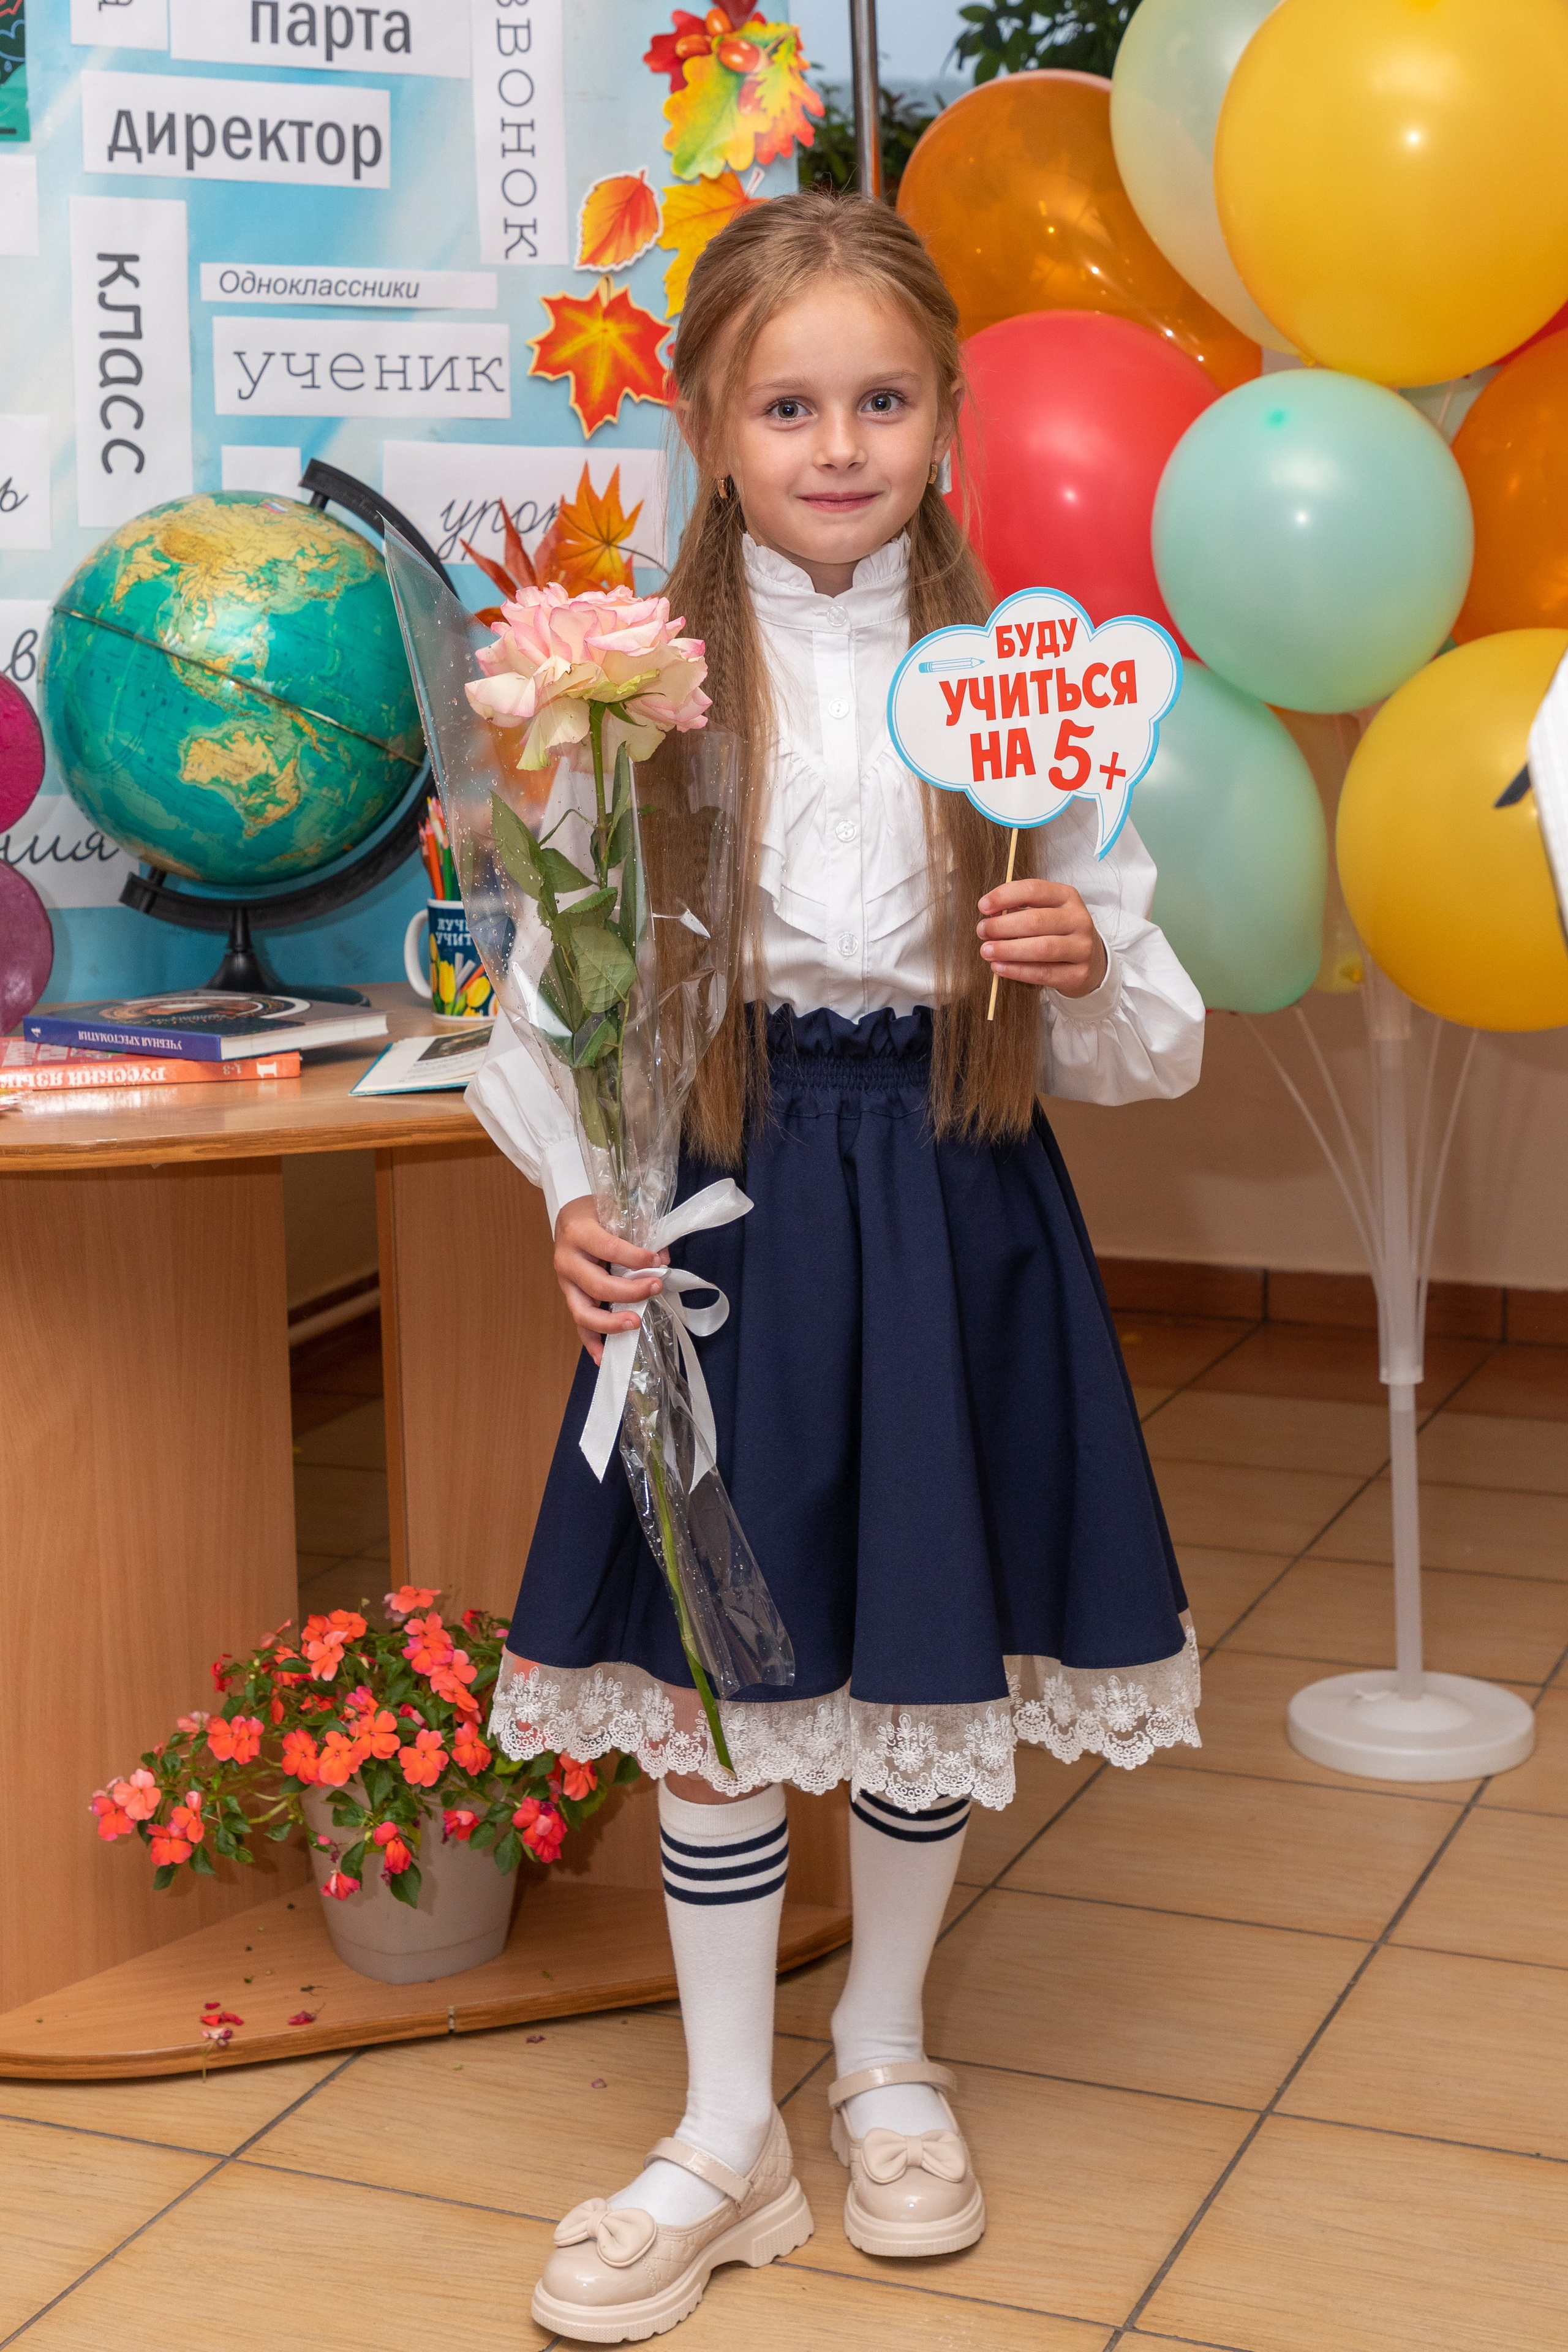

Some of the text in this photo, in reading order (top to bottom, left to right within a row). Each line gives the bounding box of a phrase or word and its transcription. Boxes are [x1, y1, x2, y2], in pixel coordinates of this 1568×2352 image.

[251, 0, 412, 62] парта
[107, 108, 383, 180] директор
[496, 0, 538, 260] вонок
[219, 269, 421, 300] Одноклассники
[96, 252, 145, 475] класс
[233, 350, 505, 401] ученик
[995, 617, 1079, 660] БУДУ
[938, 658, 1138, 727] УЧИТЬСЯ
[970, 726, 1036, 783] НА
[437, 918, 470, 932] ЛУЧ
[78, 1030, 183, 1050] УЧЕБНАЯ ХРЕСТОМАТИЯ
[67, 1067, 167, 1087] РУССКИЙ
